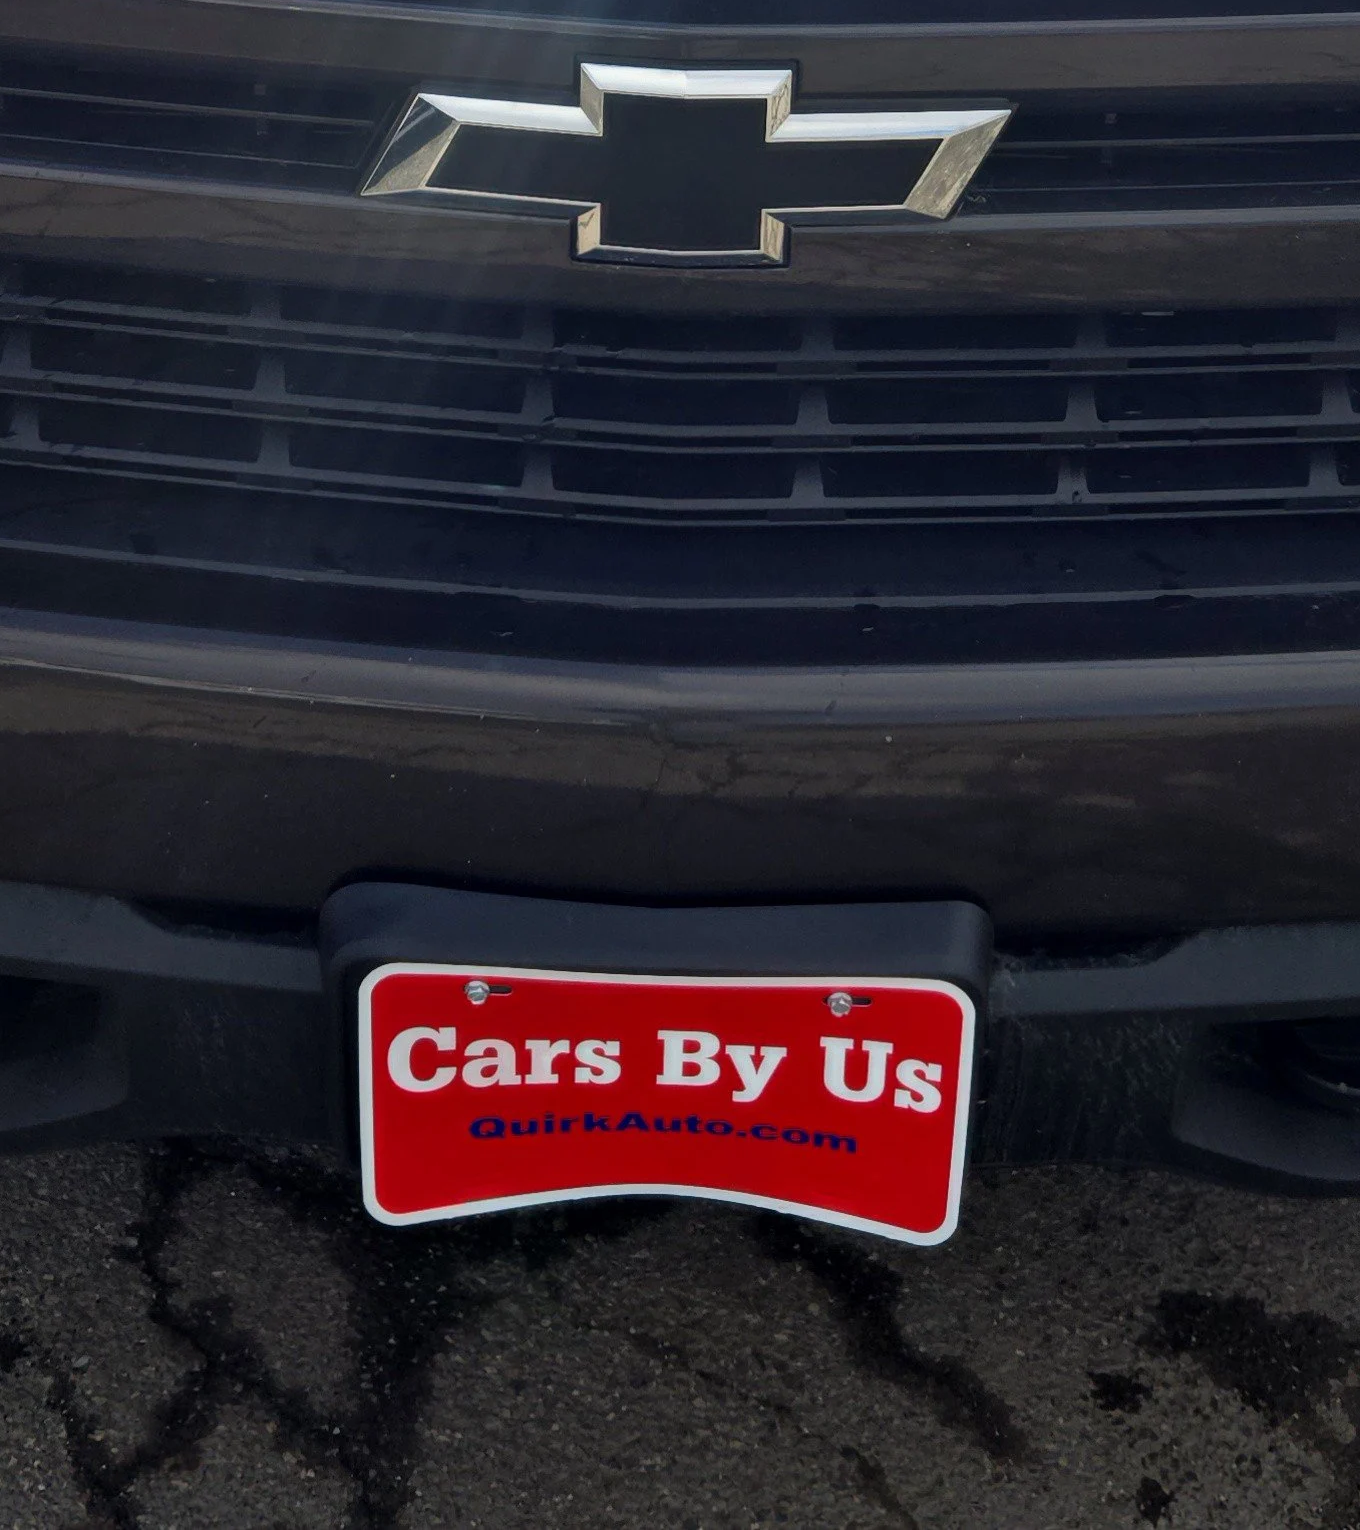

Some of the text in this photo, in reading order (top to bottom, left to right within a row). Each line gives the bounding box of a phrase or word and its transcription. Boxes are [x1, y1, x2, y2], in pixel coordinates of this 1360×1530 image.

[386, 1026, 942, 1114] Cars By Us
[468, 1111, 858, 1154] QuirkAuto.com
